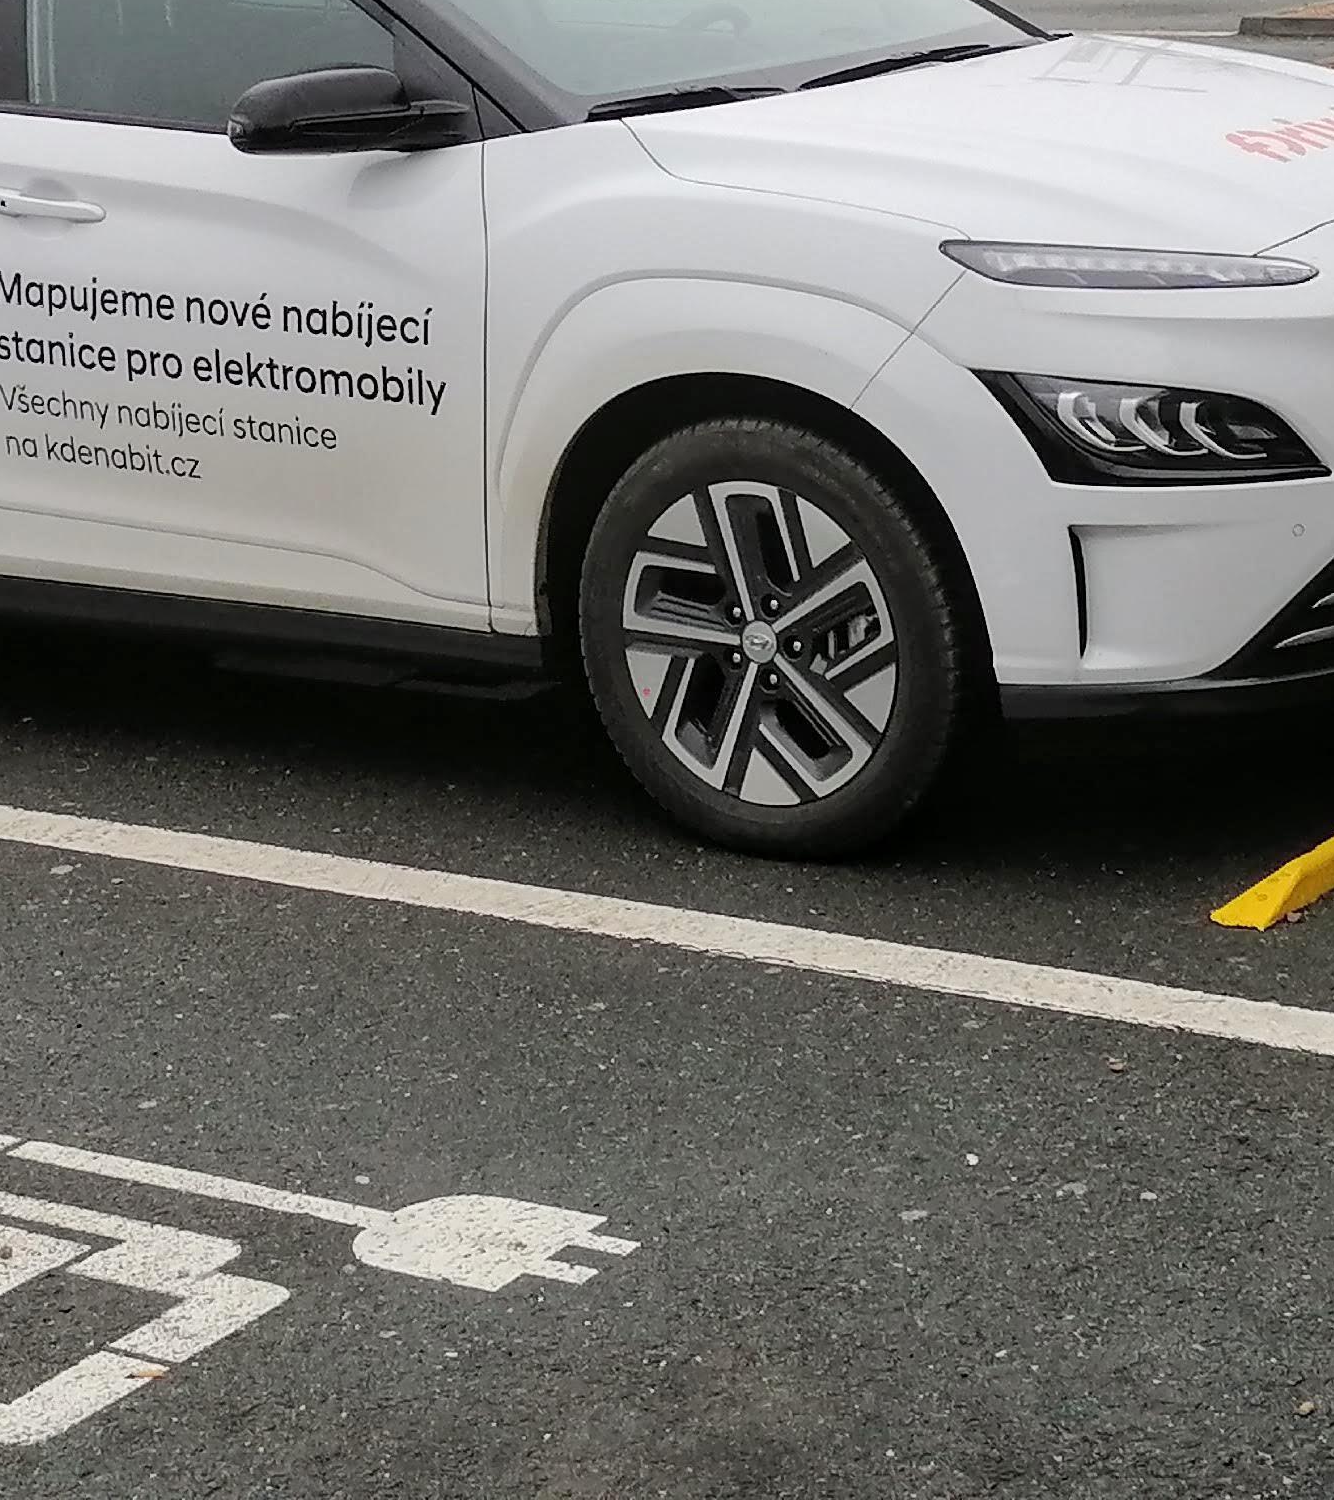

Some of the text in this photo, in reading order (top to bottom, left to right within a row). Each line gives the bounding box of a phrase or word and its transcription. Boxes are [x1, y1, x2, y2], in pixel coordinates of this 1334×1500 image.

[186, 292, 272, 330] nové
[282, 300, 433, 348] nabíjecí
[126, 349, 183, 382] pro
[193, 348, 447, 416] elektromobily
[117, 401, 224, 438] nabíjecí
[233, 415, 338, 450] stanice
[5, 433, 203, 479] na kdenabit.cz
